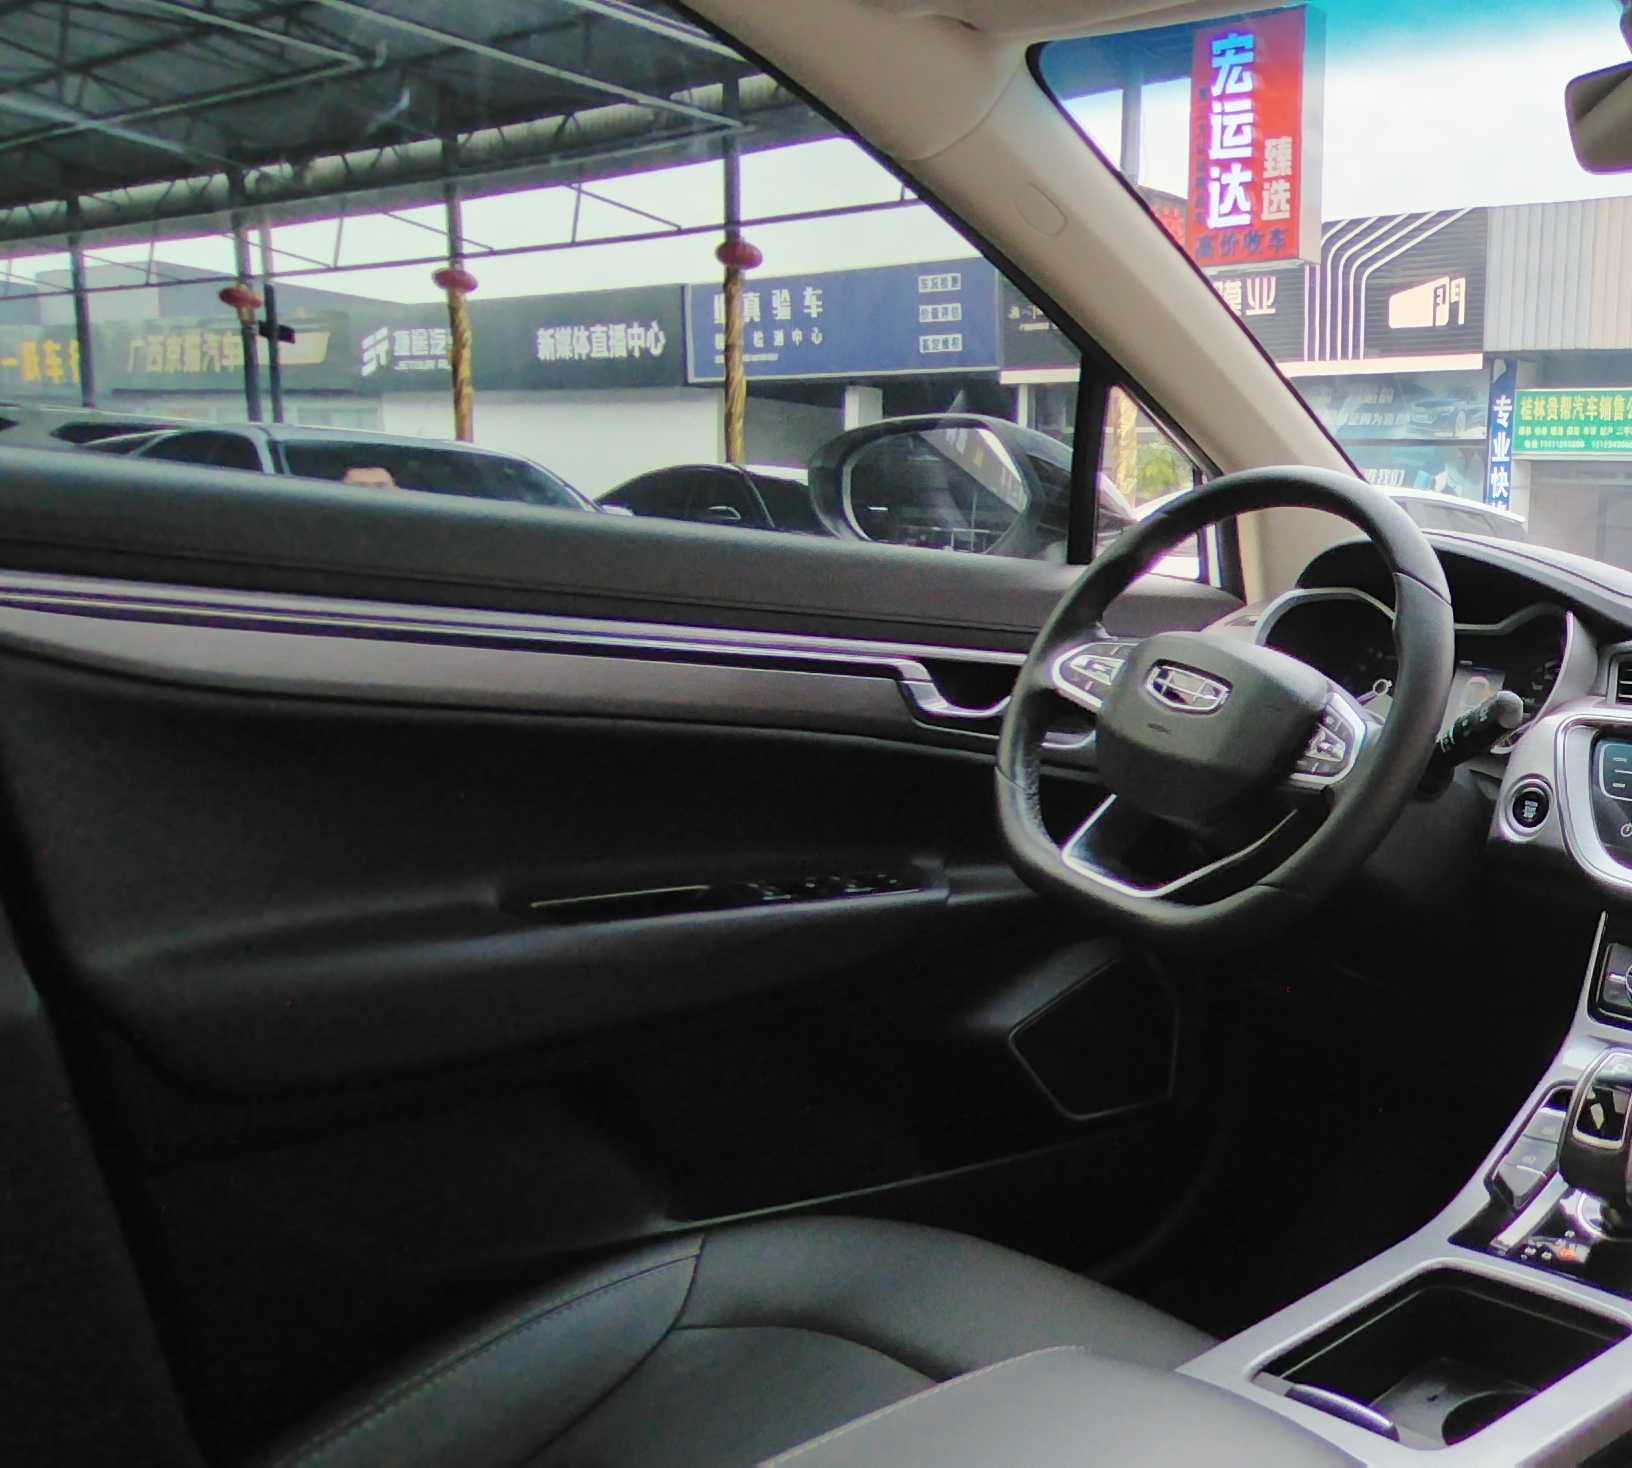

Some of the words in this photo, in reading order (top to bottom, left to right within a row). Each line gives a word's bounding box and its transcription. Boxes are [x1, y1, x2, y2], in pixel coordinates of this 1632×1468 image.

[1207, 31, 1254, 229] 宏运达
[1261, 136, 1293, 221] 臻选
[536, 320, 667, 361] 新媒体直播中心
[1490, 395, 1513, 511] 专业快
